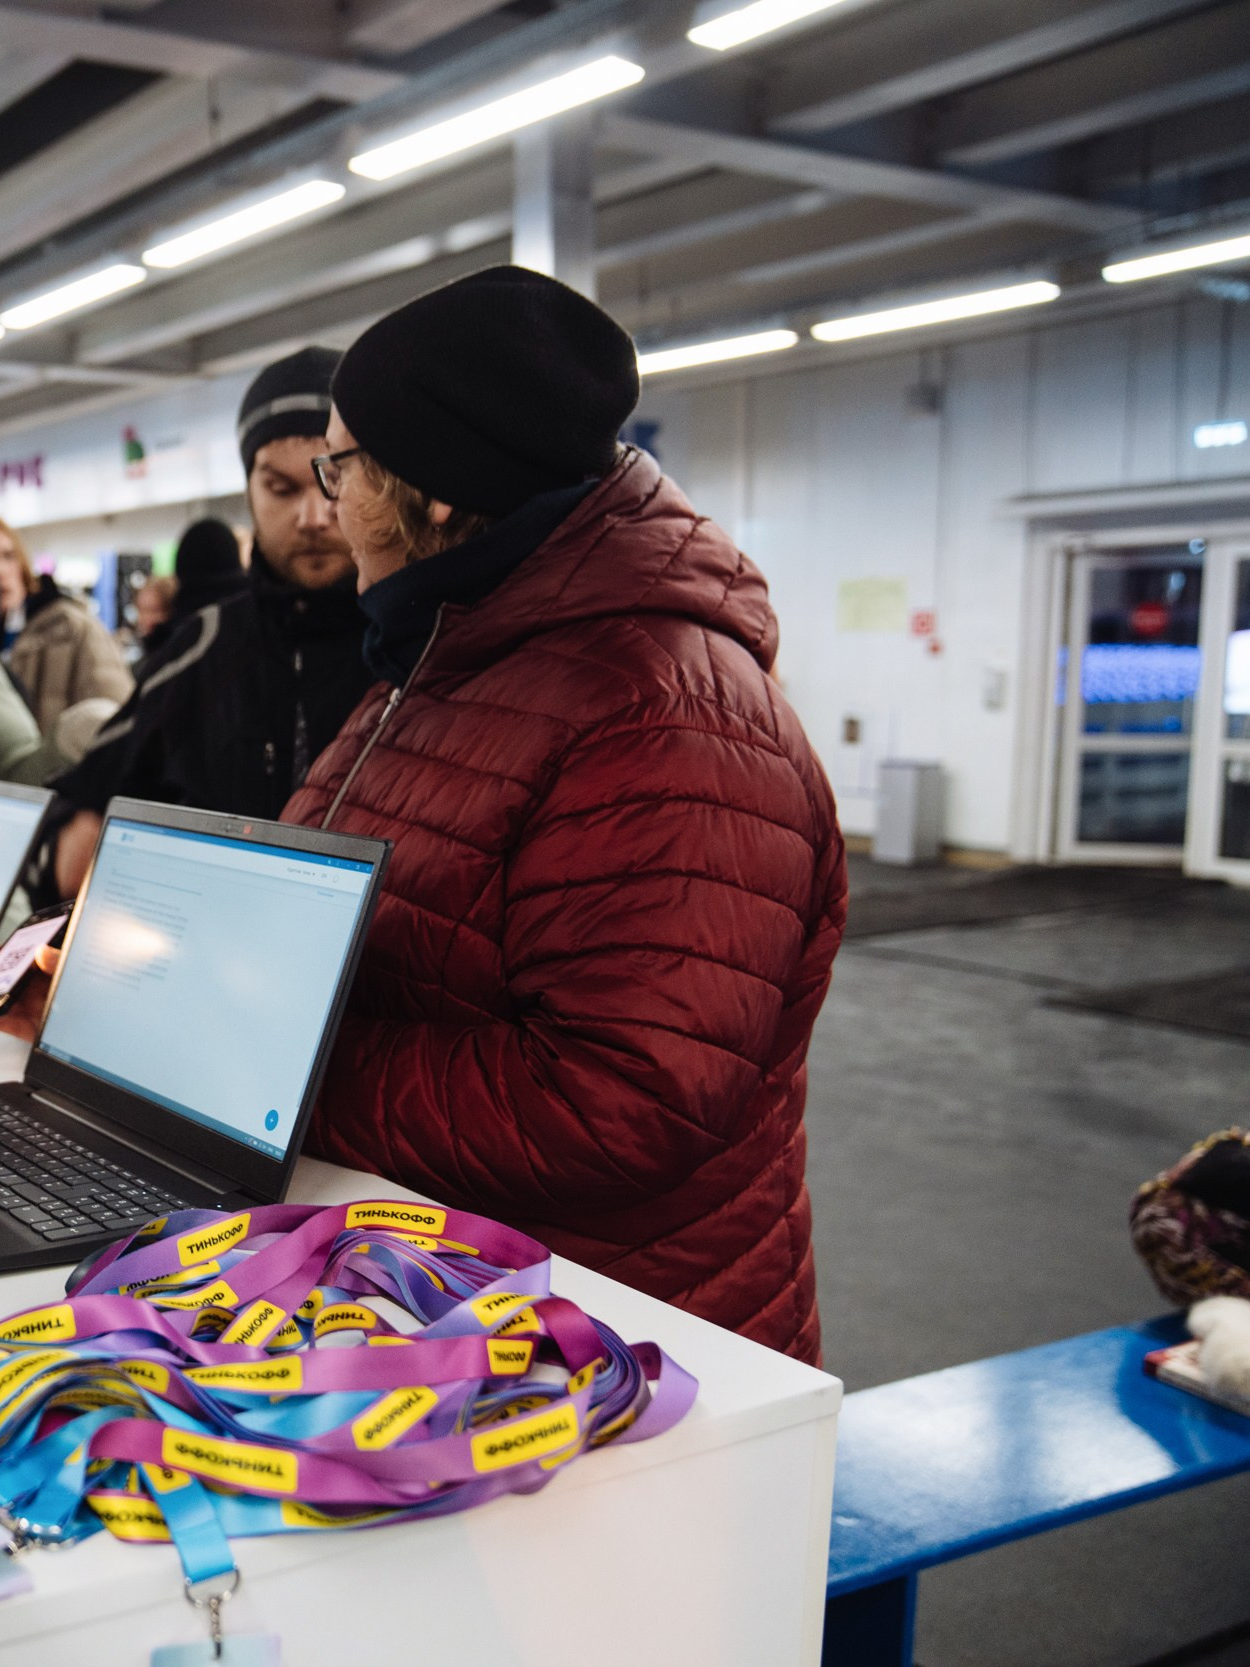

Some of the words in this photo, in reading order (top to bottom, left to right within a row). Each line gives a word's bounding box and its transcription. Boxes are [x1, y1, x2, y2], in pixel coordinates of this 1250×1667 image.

[354, 1209, 436, 1225] ТИНЬКОФФ
[186, 1223, 244, 1254] ТИНЬКОФФ
[190, 1367, 291, 1380] ТИНЬКОФФ
[364, 1390, 424, 1441] ТИНЬКОФФ
[484, 1418, 572, 1456] ТИНЬКОФФ
[174, 1442, 285, 1478] ТИНЬКОФФ
